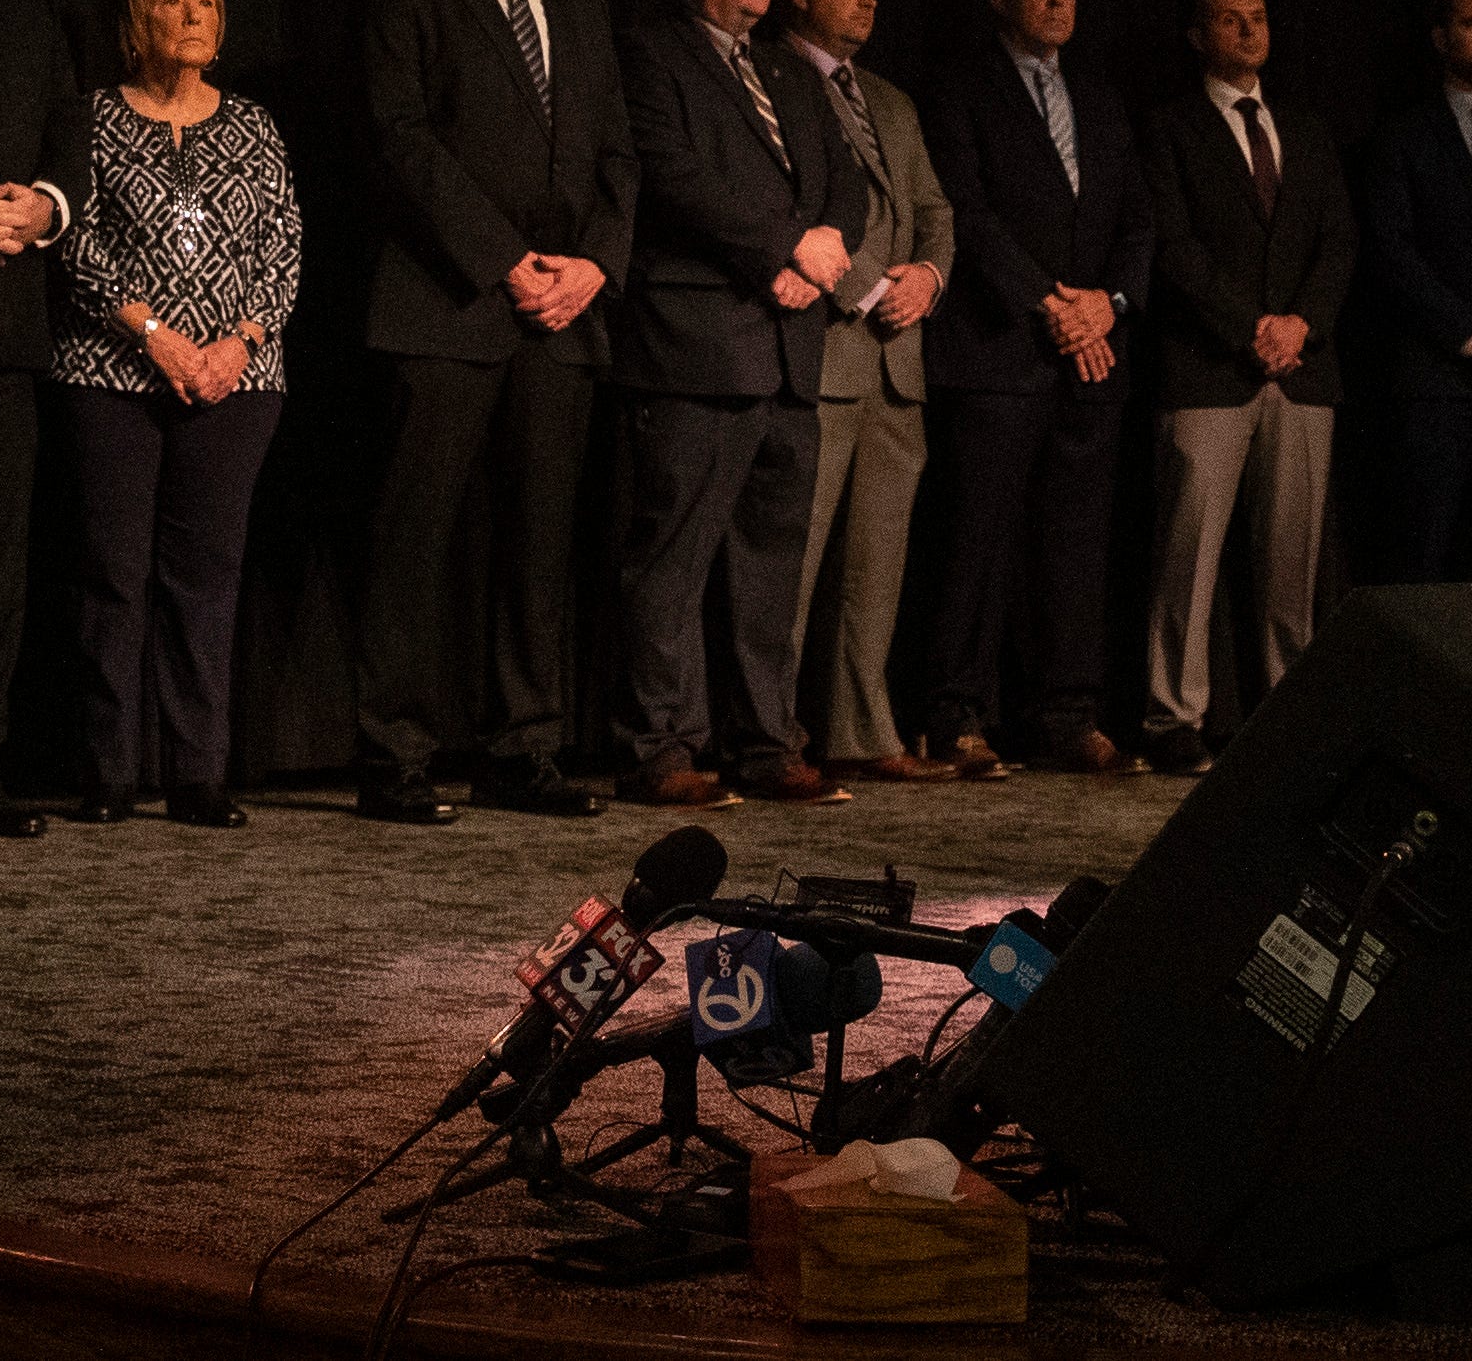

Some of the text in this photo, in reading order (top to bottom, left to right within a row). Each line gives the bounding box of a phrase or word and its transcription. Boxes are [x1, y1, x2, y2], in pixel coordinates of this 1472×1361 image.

[599, 919, 653, 976] FOX
[1017, 959, 1045, 984] USA
[561, 946, 626, 1012] 32
[541, 984, 579, 1023] NEW
